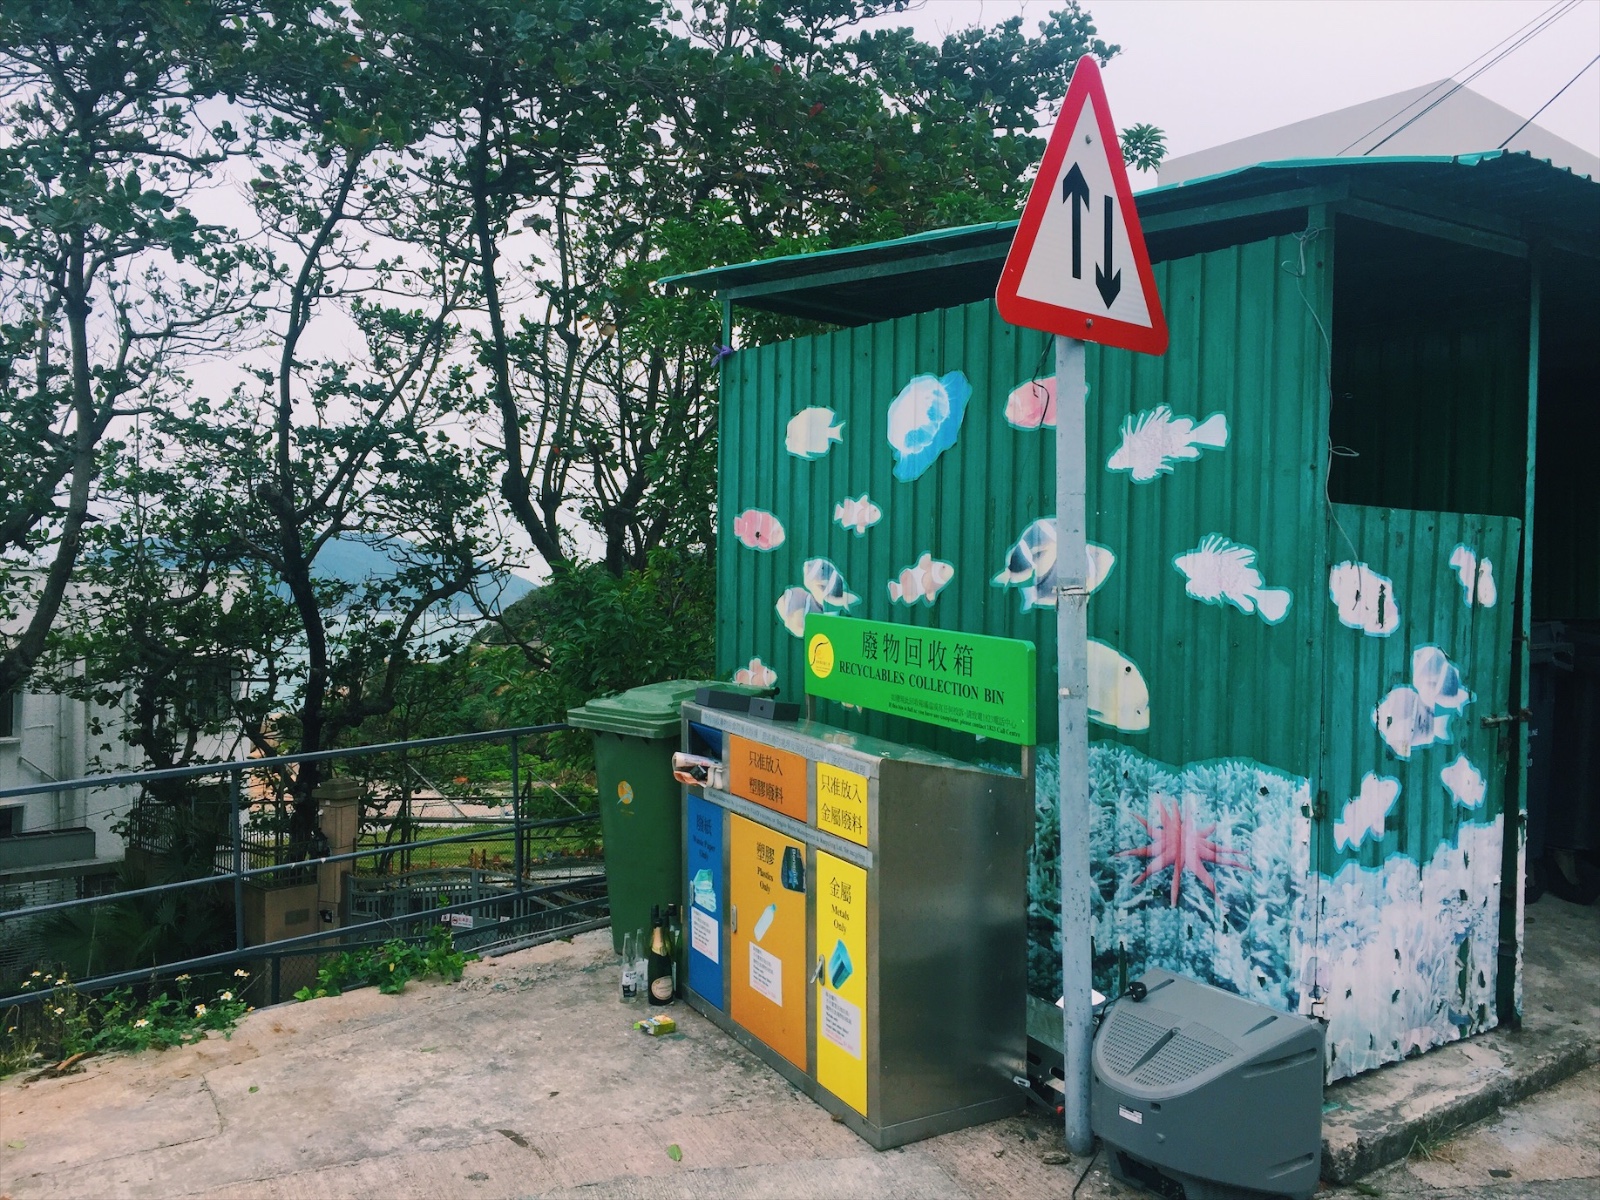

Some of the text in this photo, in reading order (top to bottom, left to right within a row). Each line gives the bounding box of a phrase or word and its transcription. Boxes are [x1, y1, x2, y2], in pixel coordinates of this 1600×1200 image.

[862, 630, 974, 678] 廢物回收箱
[839, 660, 905, 686] RECYCLABLES
[908, 673, 979, 700] COLLECTION
[984, 687, 1005, 706] BIN
[749, 750, 783, 776] 只准放入
[749, 776, 783, 804] 塑膠廢料
[821, 774, 862, 804] 只准放入
[696, 812, 713, 837] 廢紙
[821, 803, 862, 835] 金屬廢料
[692, 834, 716, 852] Waste Paper
[699, 849, 709, 861] Only
[756, 841, 775, 865] 塑膠
[757, 866, 774, 882] Plastics
[760, 880, 771, 895] Only
[830, 876, 852, 905] 金屬
[831, 903, 850, 921] Metals
[833, 918, 847, 936] Only
